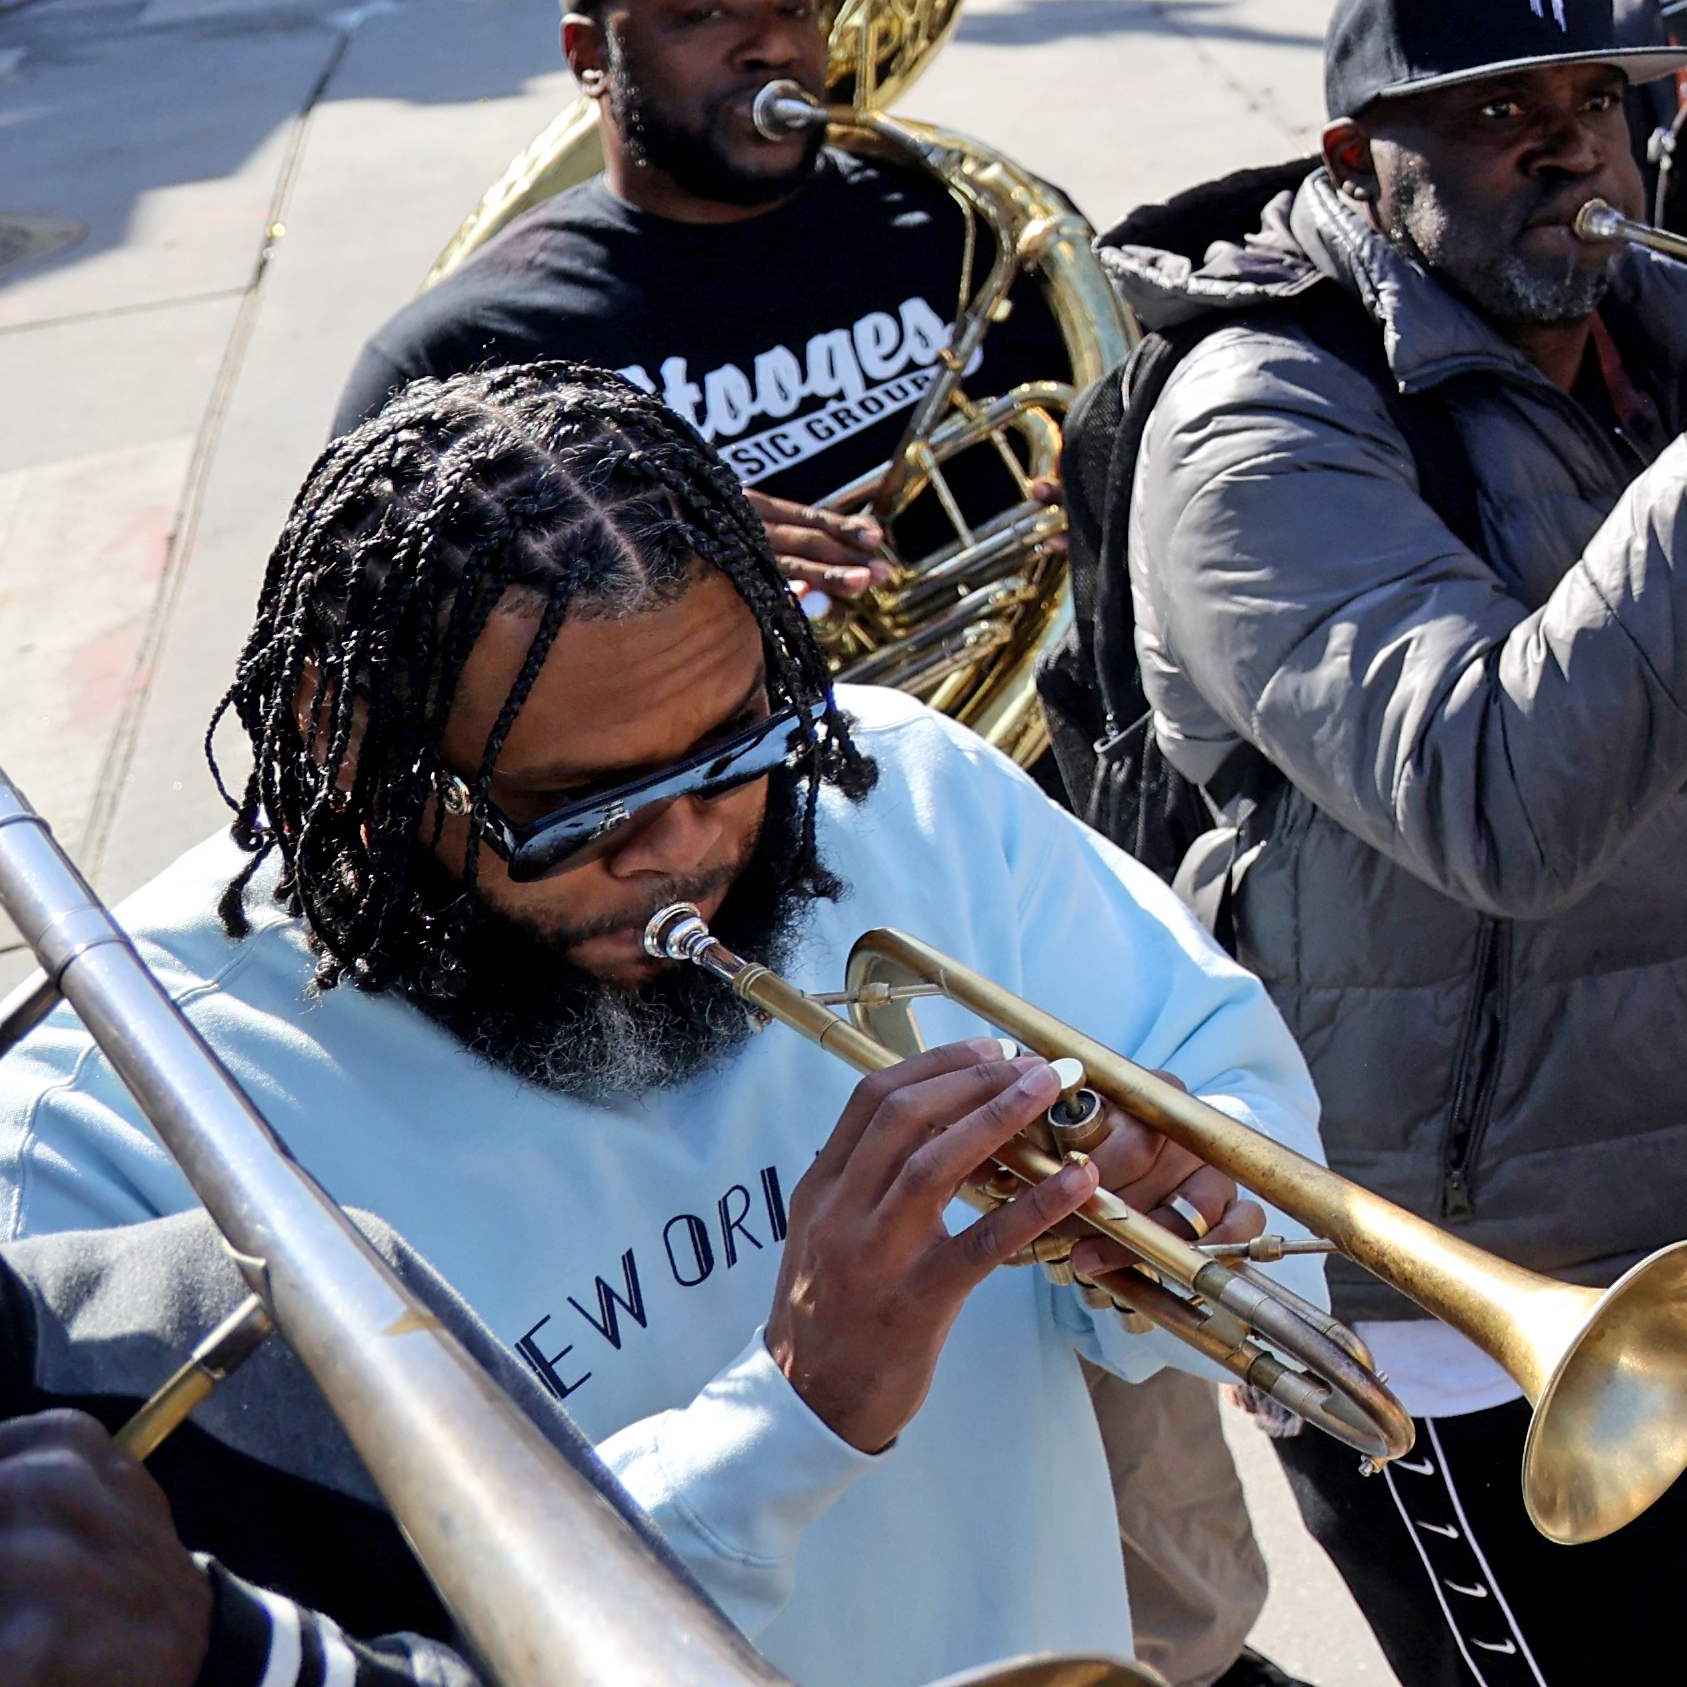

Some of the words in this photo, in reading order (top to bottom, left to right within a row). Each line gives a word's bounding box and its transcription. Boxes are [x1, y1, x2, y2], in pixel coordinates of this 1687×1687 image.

[616, 297, 983, 441] tooges
[731, 432, 801, 476] SIC
[806, 374, 931, 442] GROUP
[514, 1248, 648, 1399] EW
